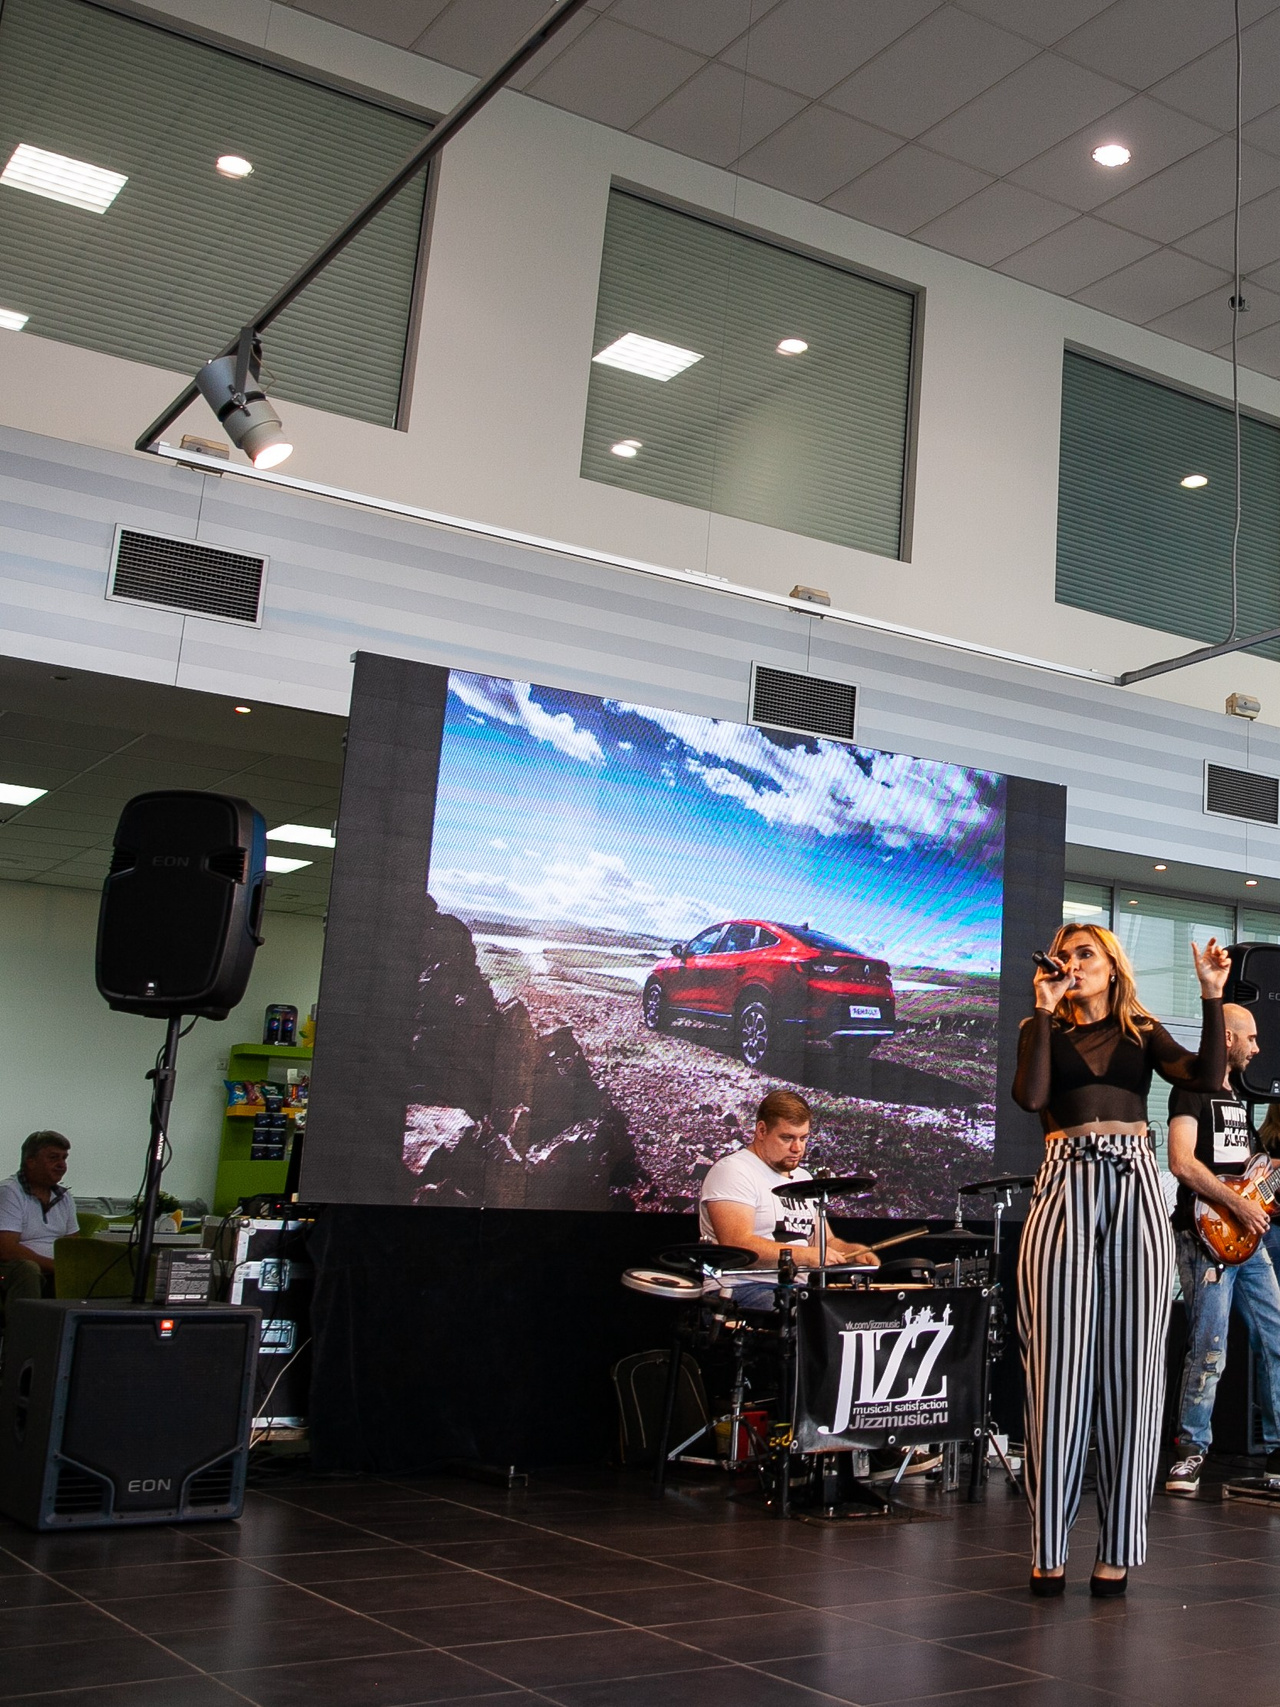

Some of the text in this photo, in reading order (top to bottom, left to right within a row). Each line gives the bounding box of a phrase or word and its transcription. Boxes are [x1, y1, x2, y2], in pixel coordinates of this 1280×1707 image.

[152, 856, 190, 867] EON
[845, 1320, 901, 1331] vk.com/jizzmusic
[817, 1324, 954, 1435] JIZZ
[853, 1399, 948, 1415] musical satisfaction
[849, 1411, 949, 1430] Jizzmusic.ru
[128, 1479, 171, 1492] EON
